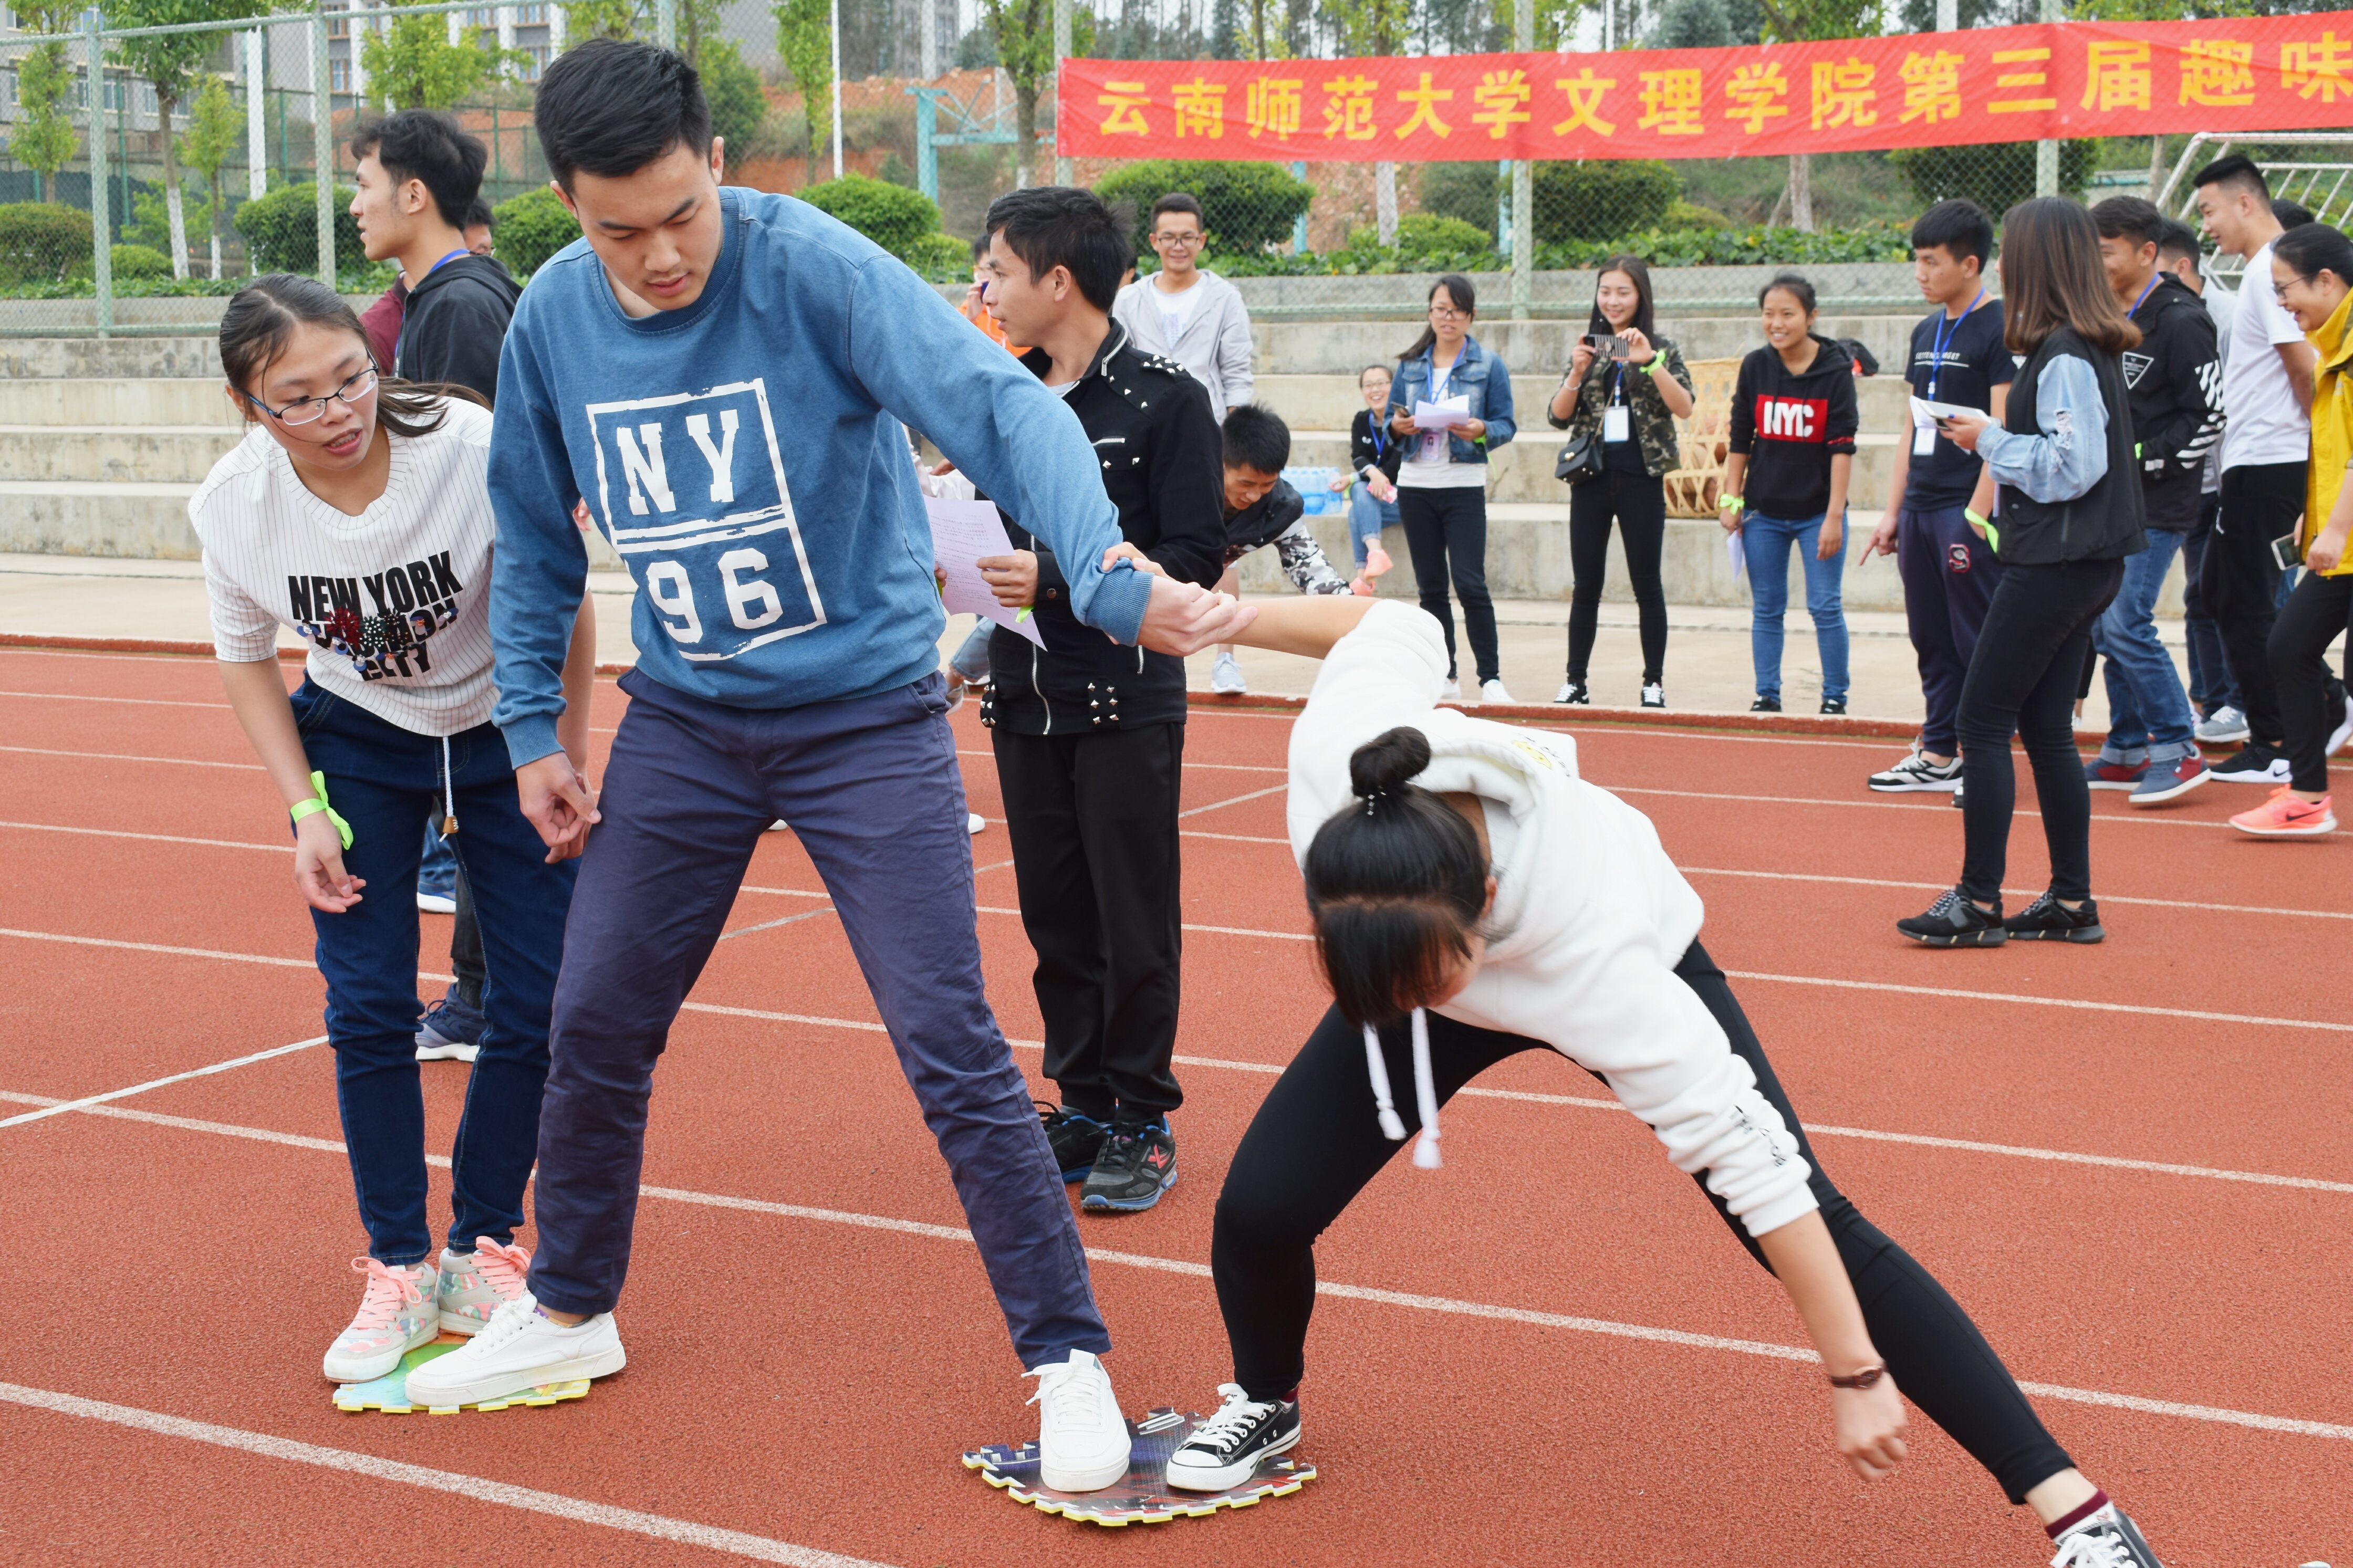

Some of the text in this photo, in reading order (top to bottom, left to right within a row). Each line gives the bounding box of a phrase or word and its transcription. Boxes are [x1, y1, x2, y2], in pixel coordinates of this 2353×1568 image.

[1097, 31, 2353, 141] 云南师范大学文理学院第三届趣味
[617, 409, 740, 515] NY
[288, 550, 463, 622] NEW YORK
[645, 548, 783, 643] 96
